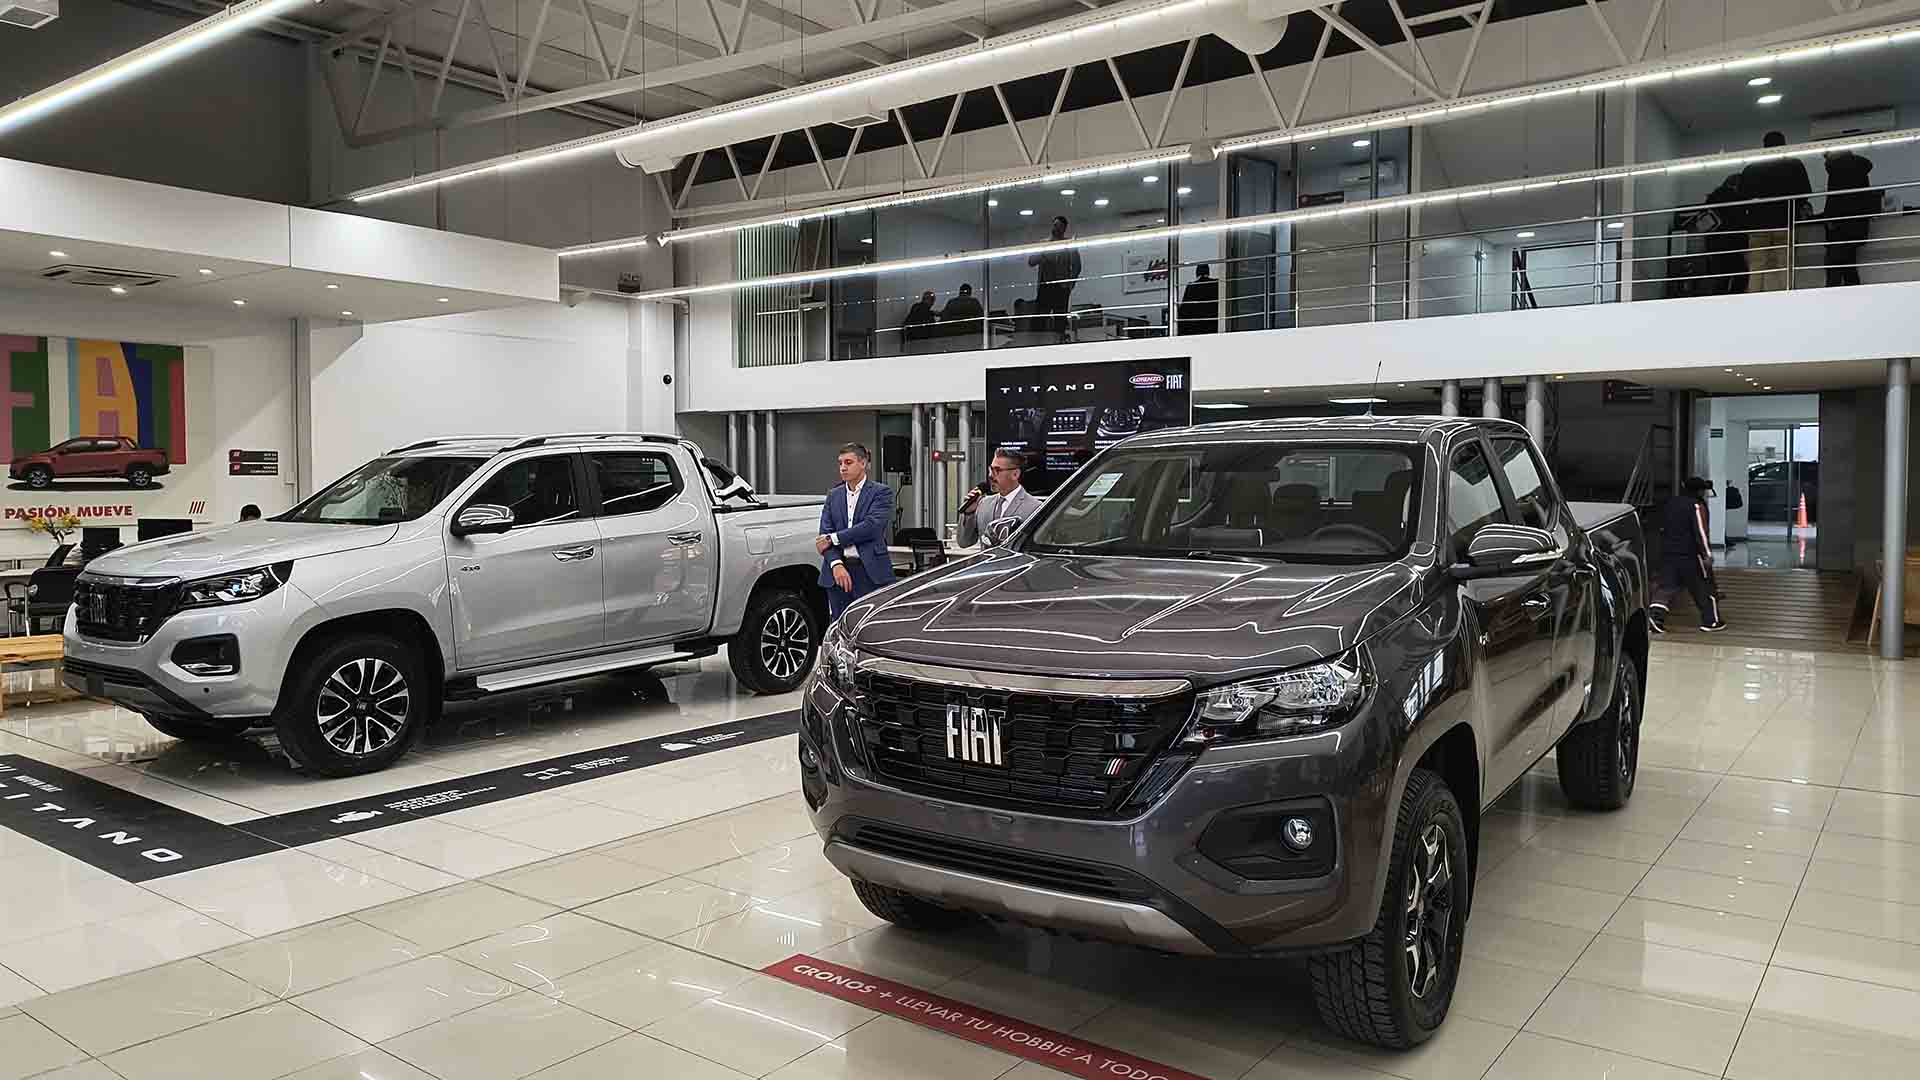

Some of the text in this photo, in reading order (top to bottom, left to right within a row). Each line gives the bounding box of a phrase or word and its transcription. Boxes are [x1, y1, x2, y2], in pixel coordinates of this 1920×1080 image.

[1000, 383, 1095, 394] TITANO
[1166, 374, 1183, 390] FIAT
[5, 505, 133, 519] PASIÓN MUEVE
[946, 704, 1006, 765] FIAT
[0, 783, 183, 862] ITANO
[793, 964, 877, 993] CRONOS
[896, 996, 962, 1022] LLEVAR
[964, 1016, 993, 1030] TU
[993, 1026, 1075, 1057] HOBBIE
[1073, 1053, 1093, 1065] A
